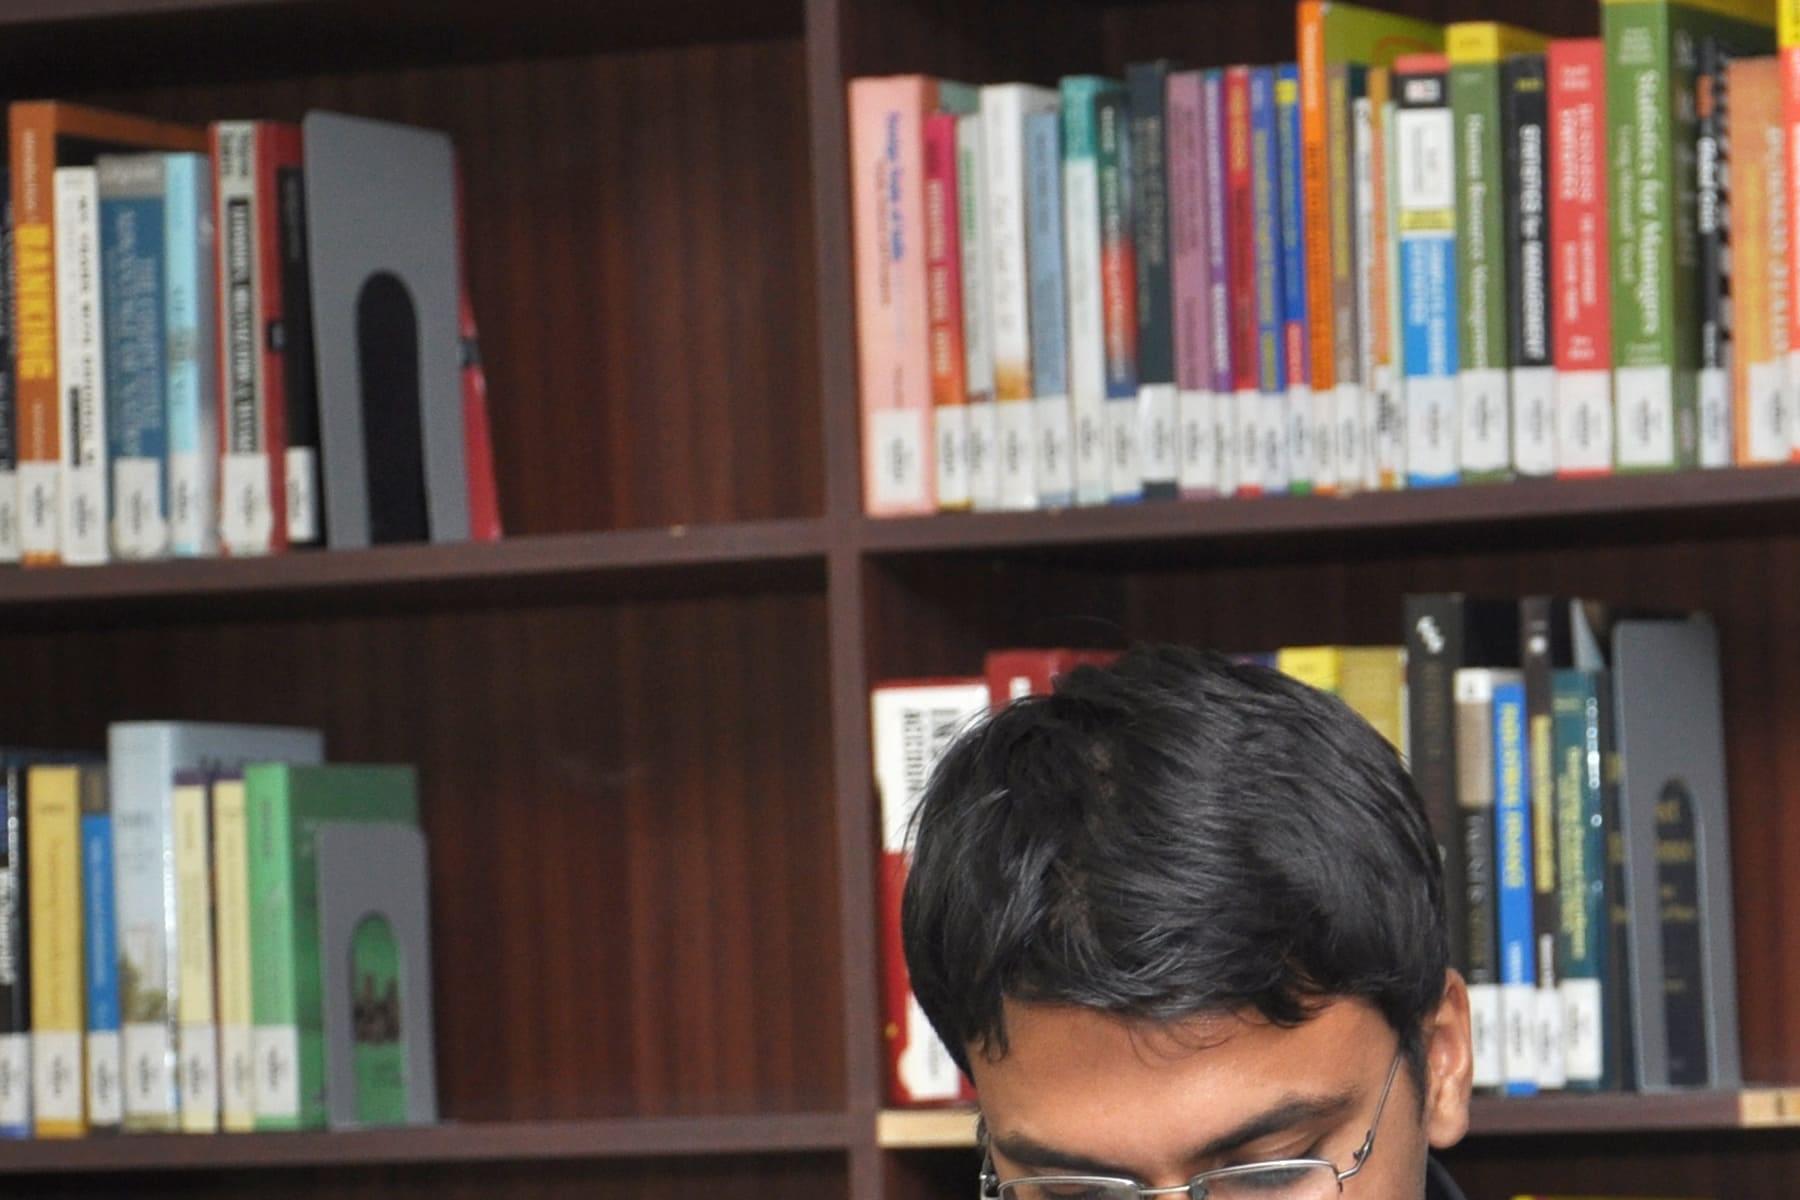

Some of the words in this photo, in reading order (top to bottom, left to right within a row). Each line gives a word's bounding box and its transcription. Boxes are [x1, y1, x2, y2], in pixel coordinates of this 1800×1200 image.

[1636, 69, 1661, 174] Statistics
[1640, 179, 1664, 213] for
[15, 223, 54, 381] BANKING
[1468, 264, 1488, 370] Managemen
[1635, 220, 1662, 335] Managers
